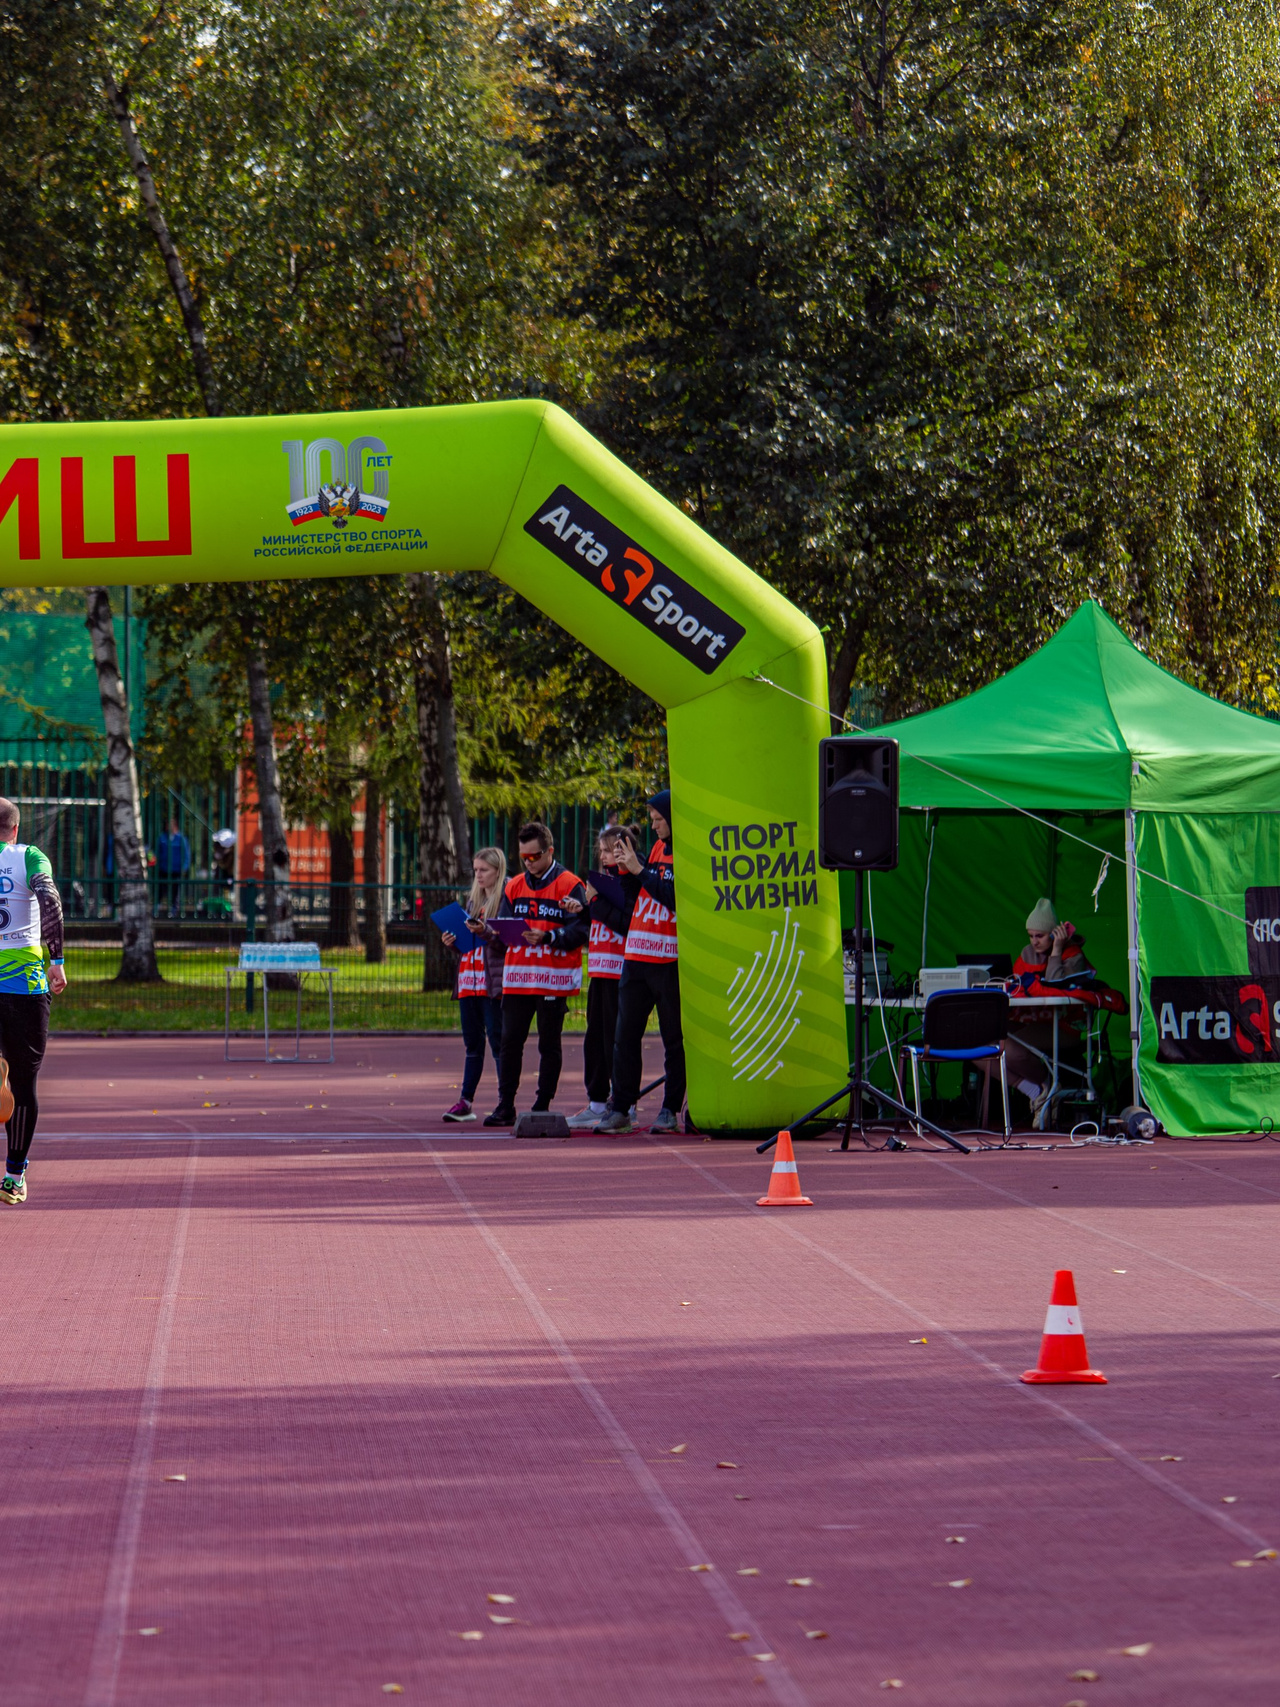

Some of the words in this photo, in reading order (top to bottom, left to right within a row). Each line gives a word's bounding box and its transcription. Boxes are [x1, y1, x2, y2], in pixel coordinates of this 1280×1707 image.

[366, 455, 393, 468] ЛЕТ
[295, 505, 314, 517] 1923
[361, 502, 382, 515] 2023
[262, 531, 368, 546] МИНИСТЕРСТВО
[371, 528, 423, 541] СПОРТА
[254, 543, 341, 558] РОССИЙСКОЙ
[345, 540, 429, 554] ФЕДЕРАЦИИ
[538, 504, 609, 568] Arta
[641, 583, 727, 660] Sport
[708, 821, 798, 852] СПОРТ
[710, 849, 817, 882] НОРМА
[713, 879, 819, 912] ЖИЗНИ
[514, 904, 528, 914] rta
[601, 958, 623, 970] СПОРТ
[551, 974, 574, 986] СПОРТ
[1160, 1002, 1231, 1041] Arta
